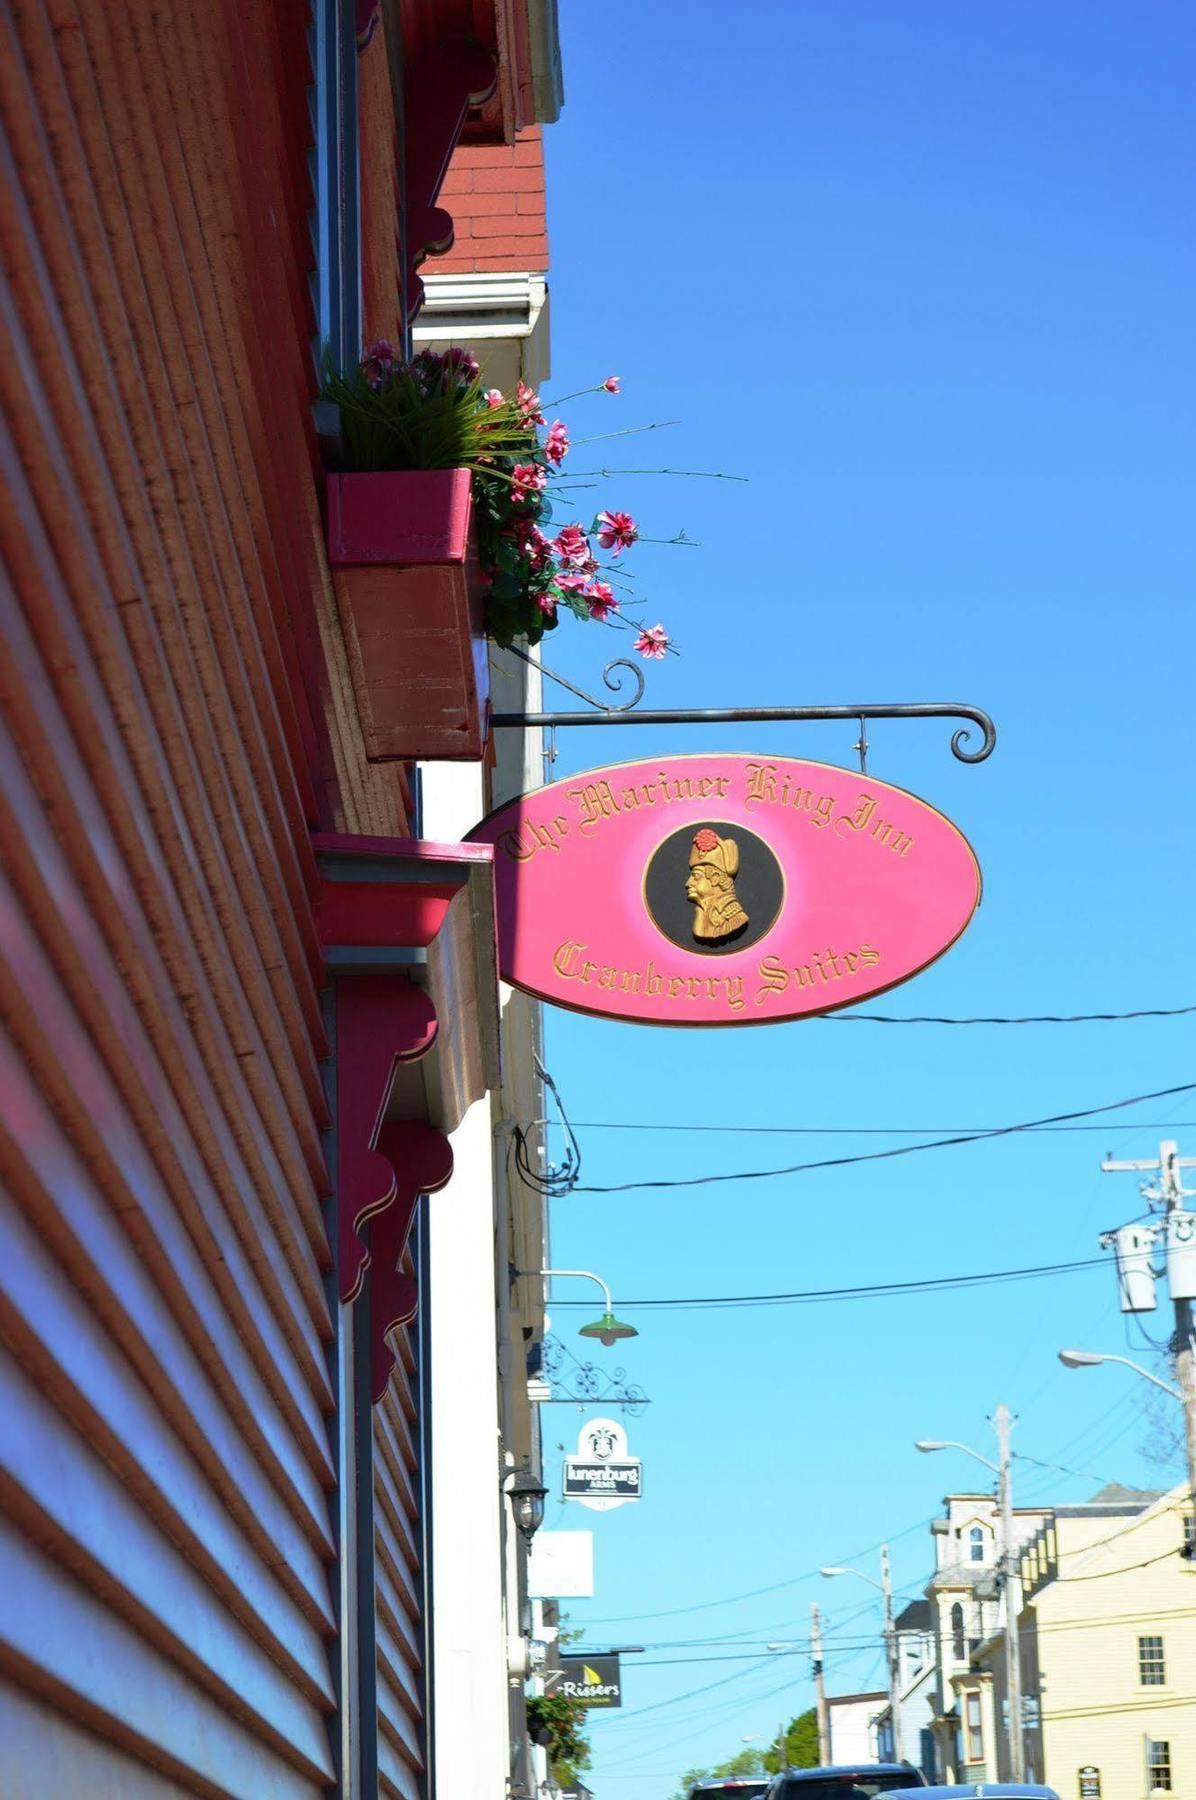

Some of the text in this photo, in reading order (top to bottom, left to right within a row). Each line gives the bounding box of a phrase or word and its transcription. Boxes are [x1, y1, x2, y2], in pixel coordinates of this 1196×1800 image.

[497, 762, 914, 863] The Mariner King Inn
[552, 939, 881, 1011] Cranberry Suites
